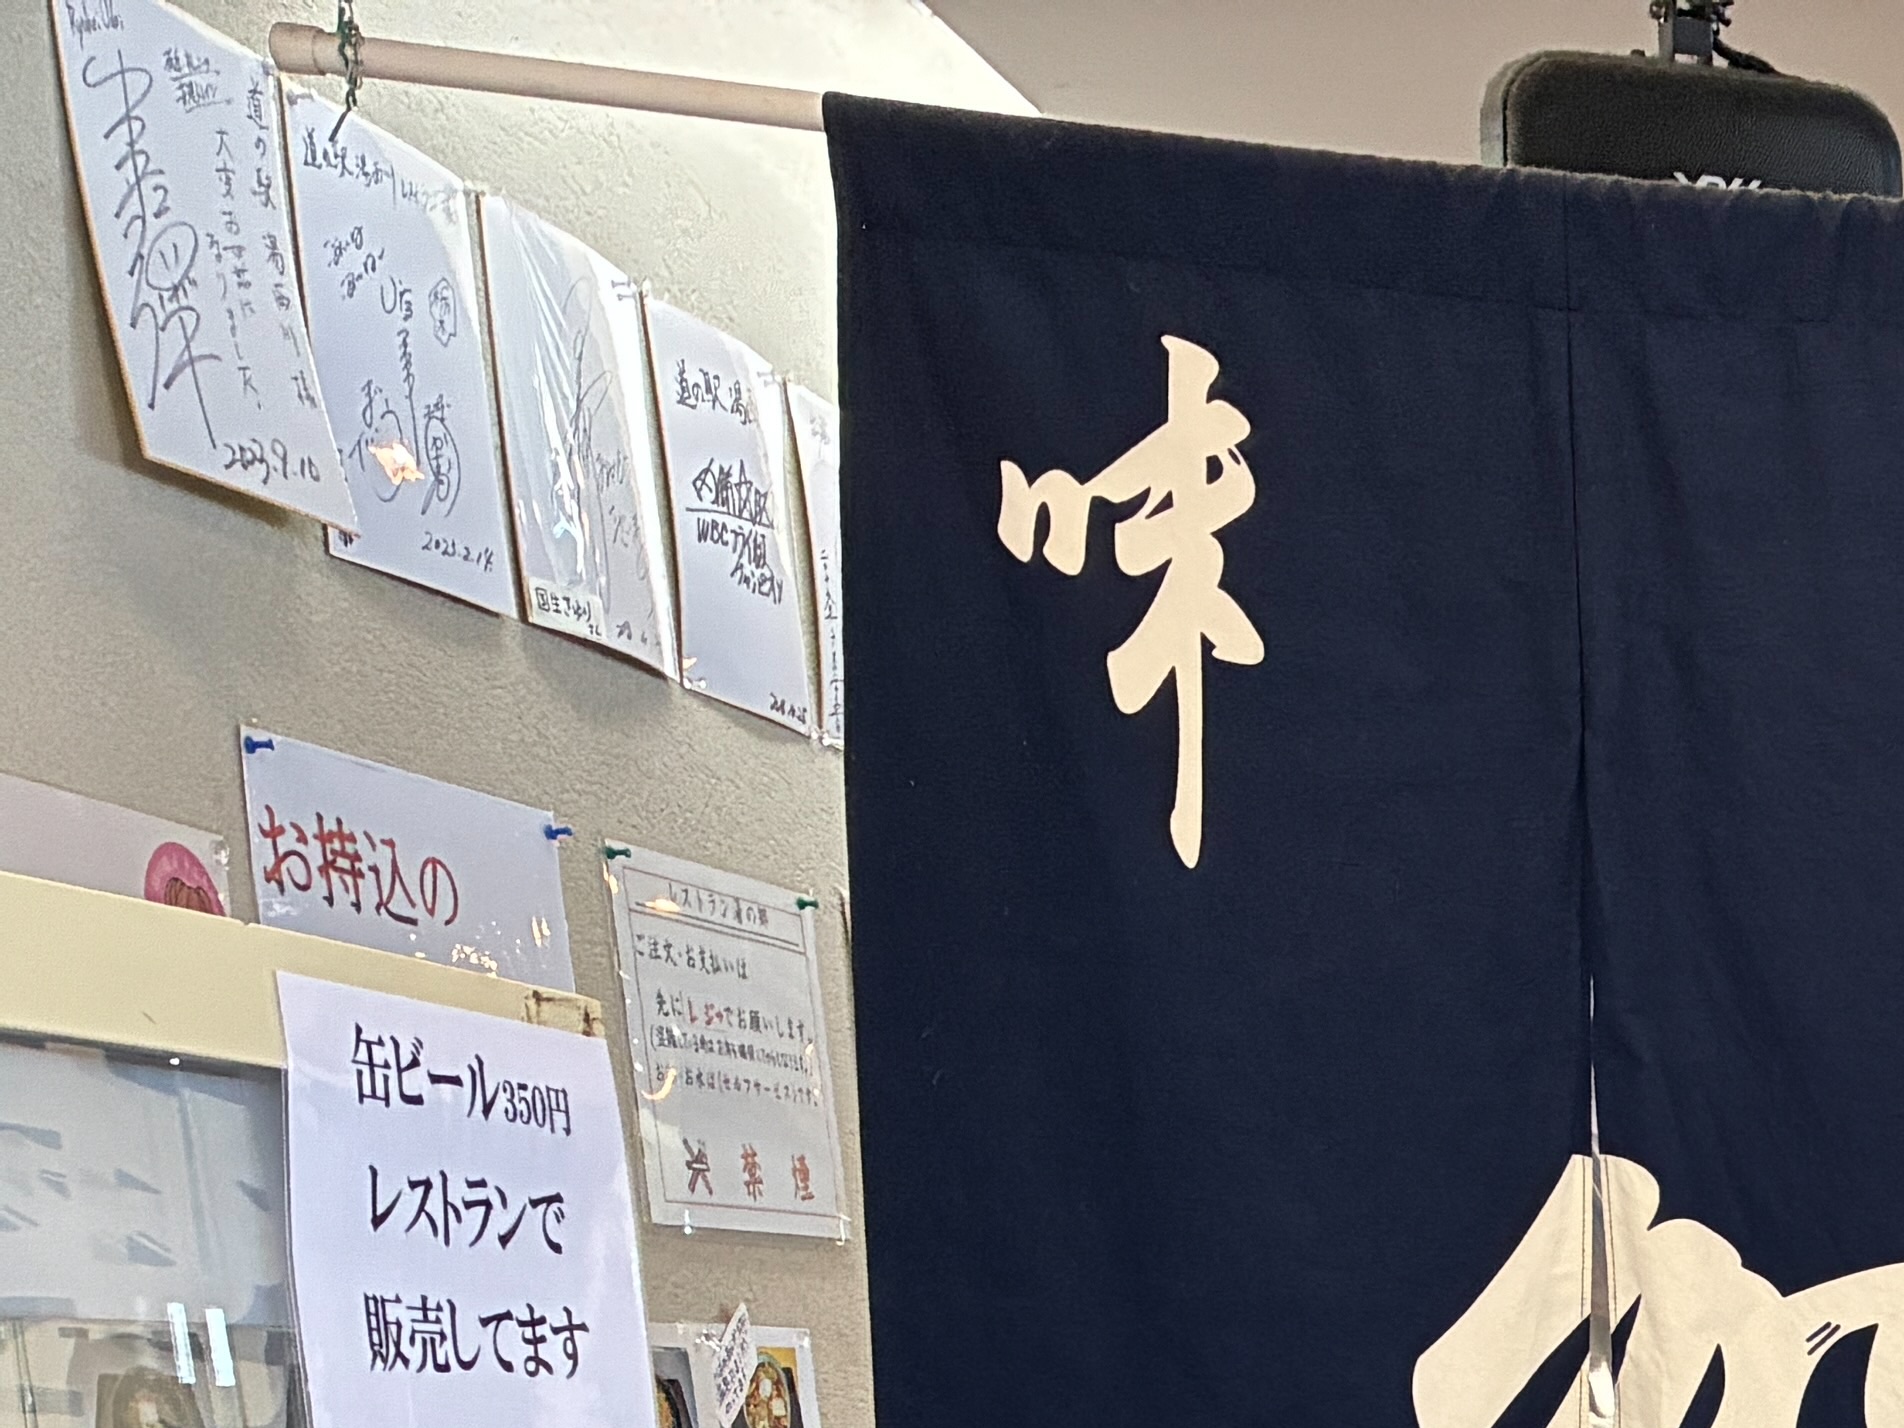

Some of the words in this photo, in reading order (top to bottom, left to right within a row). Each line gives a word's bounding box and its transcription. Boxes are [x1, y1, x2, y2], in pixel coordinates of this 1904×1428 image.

[259, 804, 461, 927] お持込の
[351, 1022, 574, 1138] 缶ビール350円
[369, 1164, 567, 1254] レストランで
[363, 1294, 589, 1380] 販売してます
